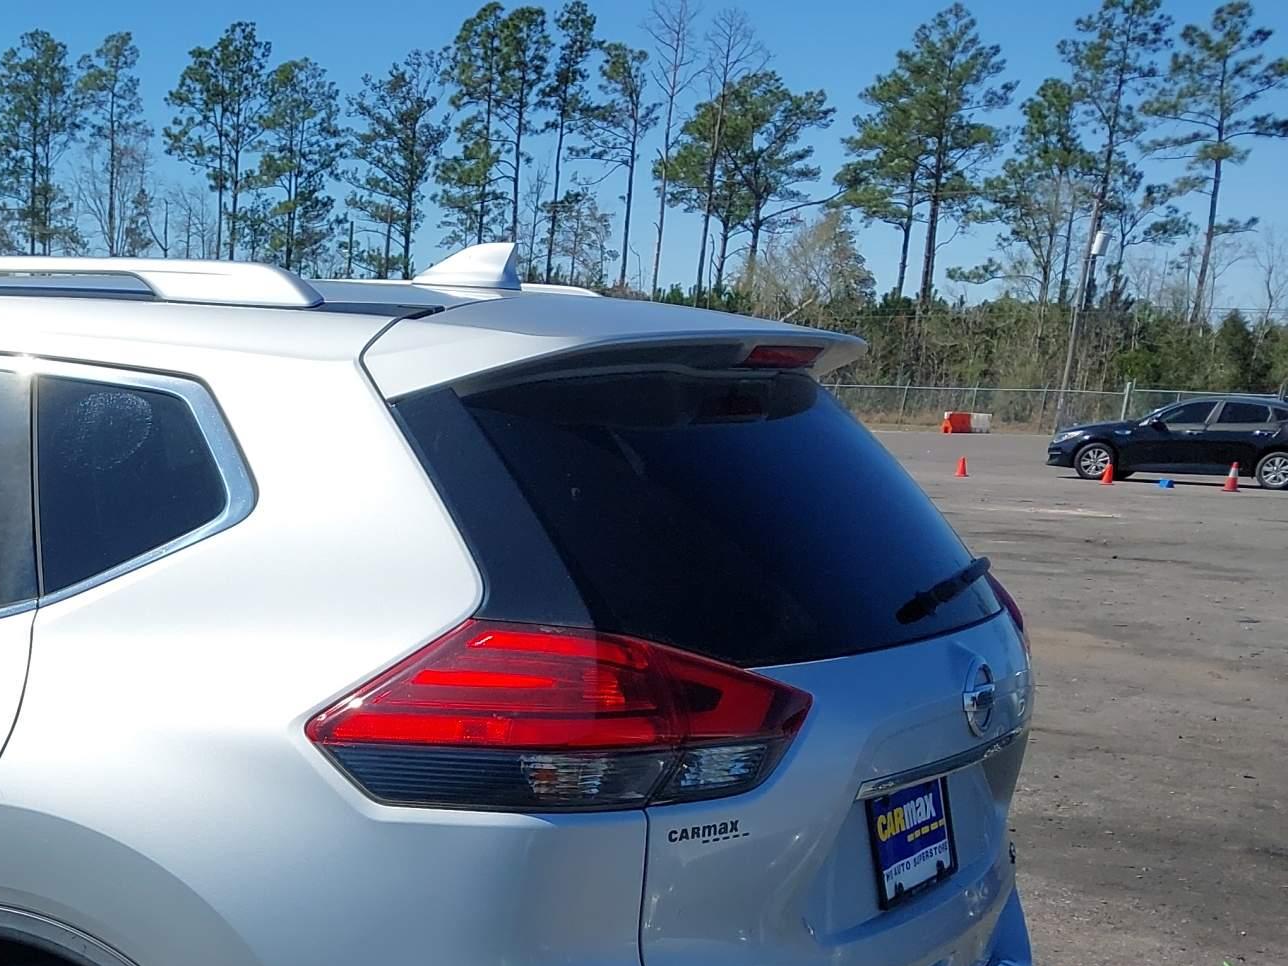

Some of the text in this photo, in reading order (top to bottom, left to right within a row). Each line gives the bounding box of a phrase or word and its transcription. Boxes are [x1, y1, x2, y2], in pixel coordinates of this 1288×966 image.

[668, 819, 740, 843] CARmax
[877, 793, 936, 842] CARmax
[894, 860, 911, 876] AUTO
[913, 841, 948, 867] SUPERSTORE
